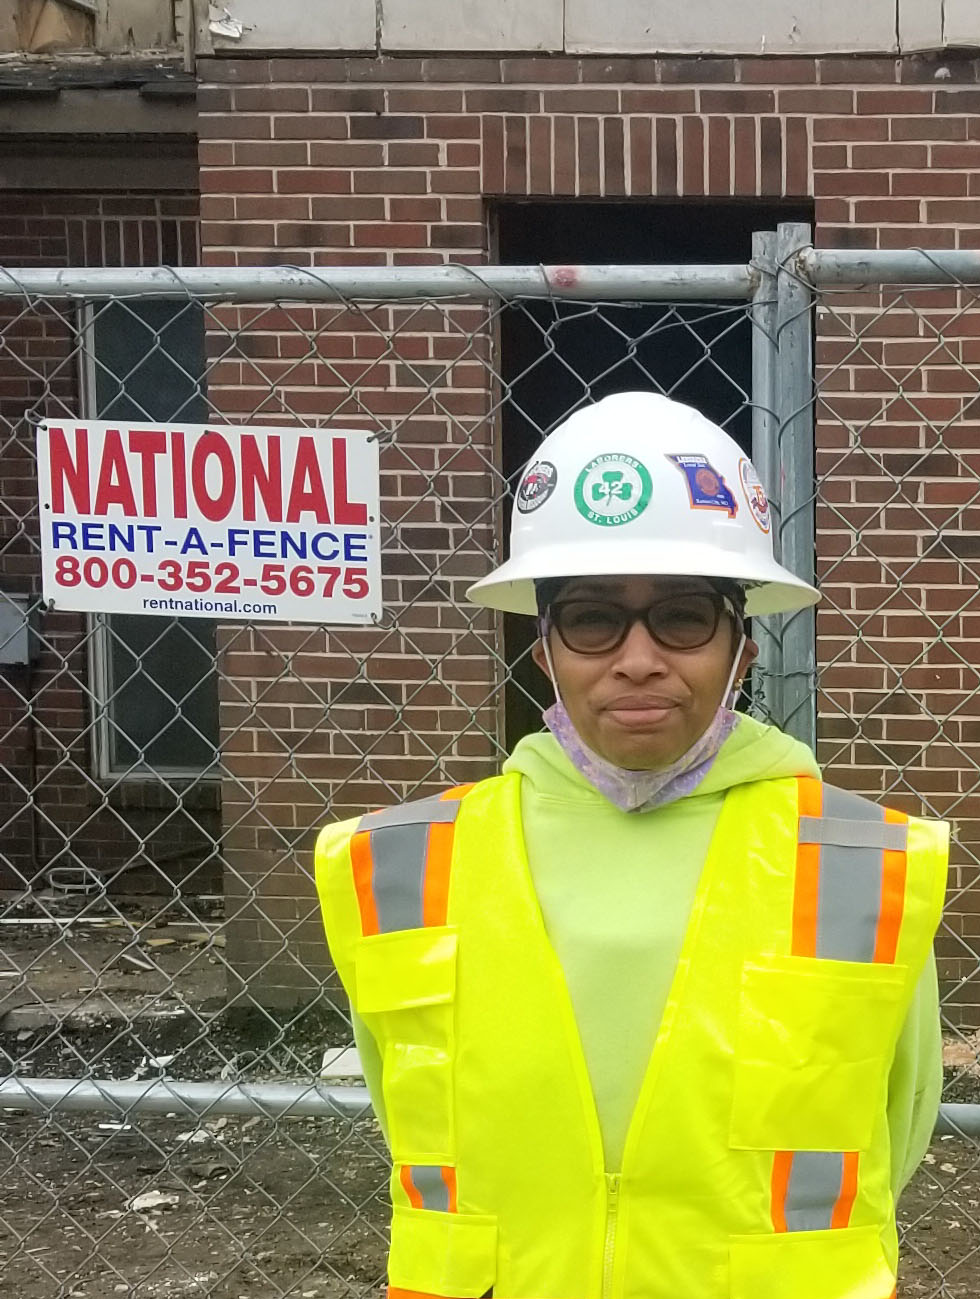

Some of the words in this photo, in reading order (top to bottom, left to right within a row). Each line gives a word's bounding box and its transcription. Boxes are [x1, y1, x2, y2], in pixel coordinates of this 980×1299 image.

[49, 428, 368, 526] NATIONAL
[599, 481, 623, 495] 42
[587, 511, 602, 524] ST.
[606, 507, 639, 525] LOUIS
[52, 521, 368, 562] RENT-A-FENCE
[55, 555, 370, 600] 800-352-5675
[142, 597, 278, 615] rentnational.com
